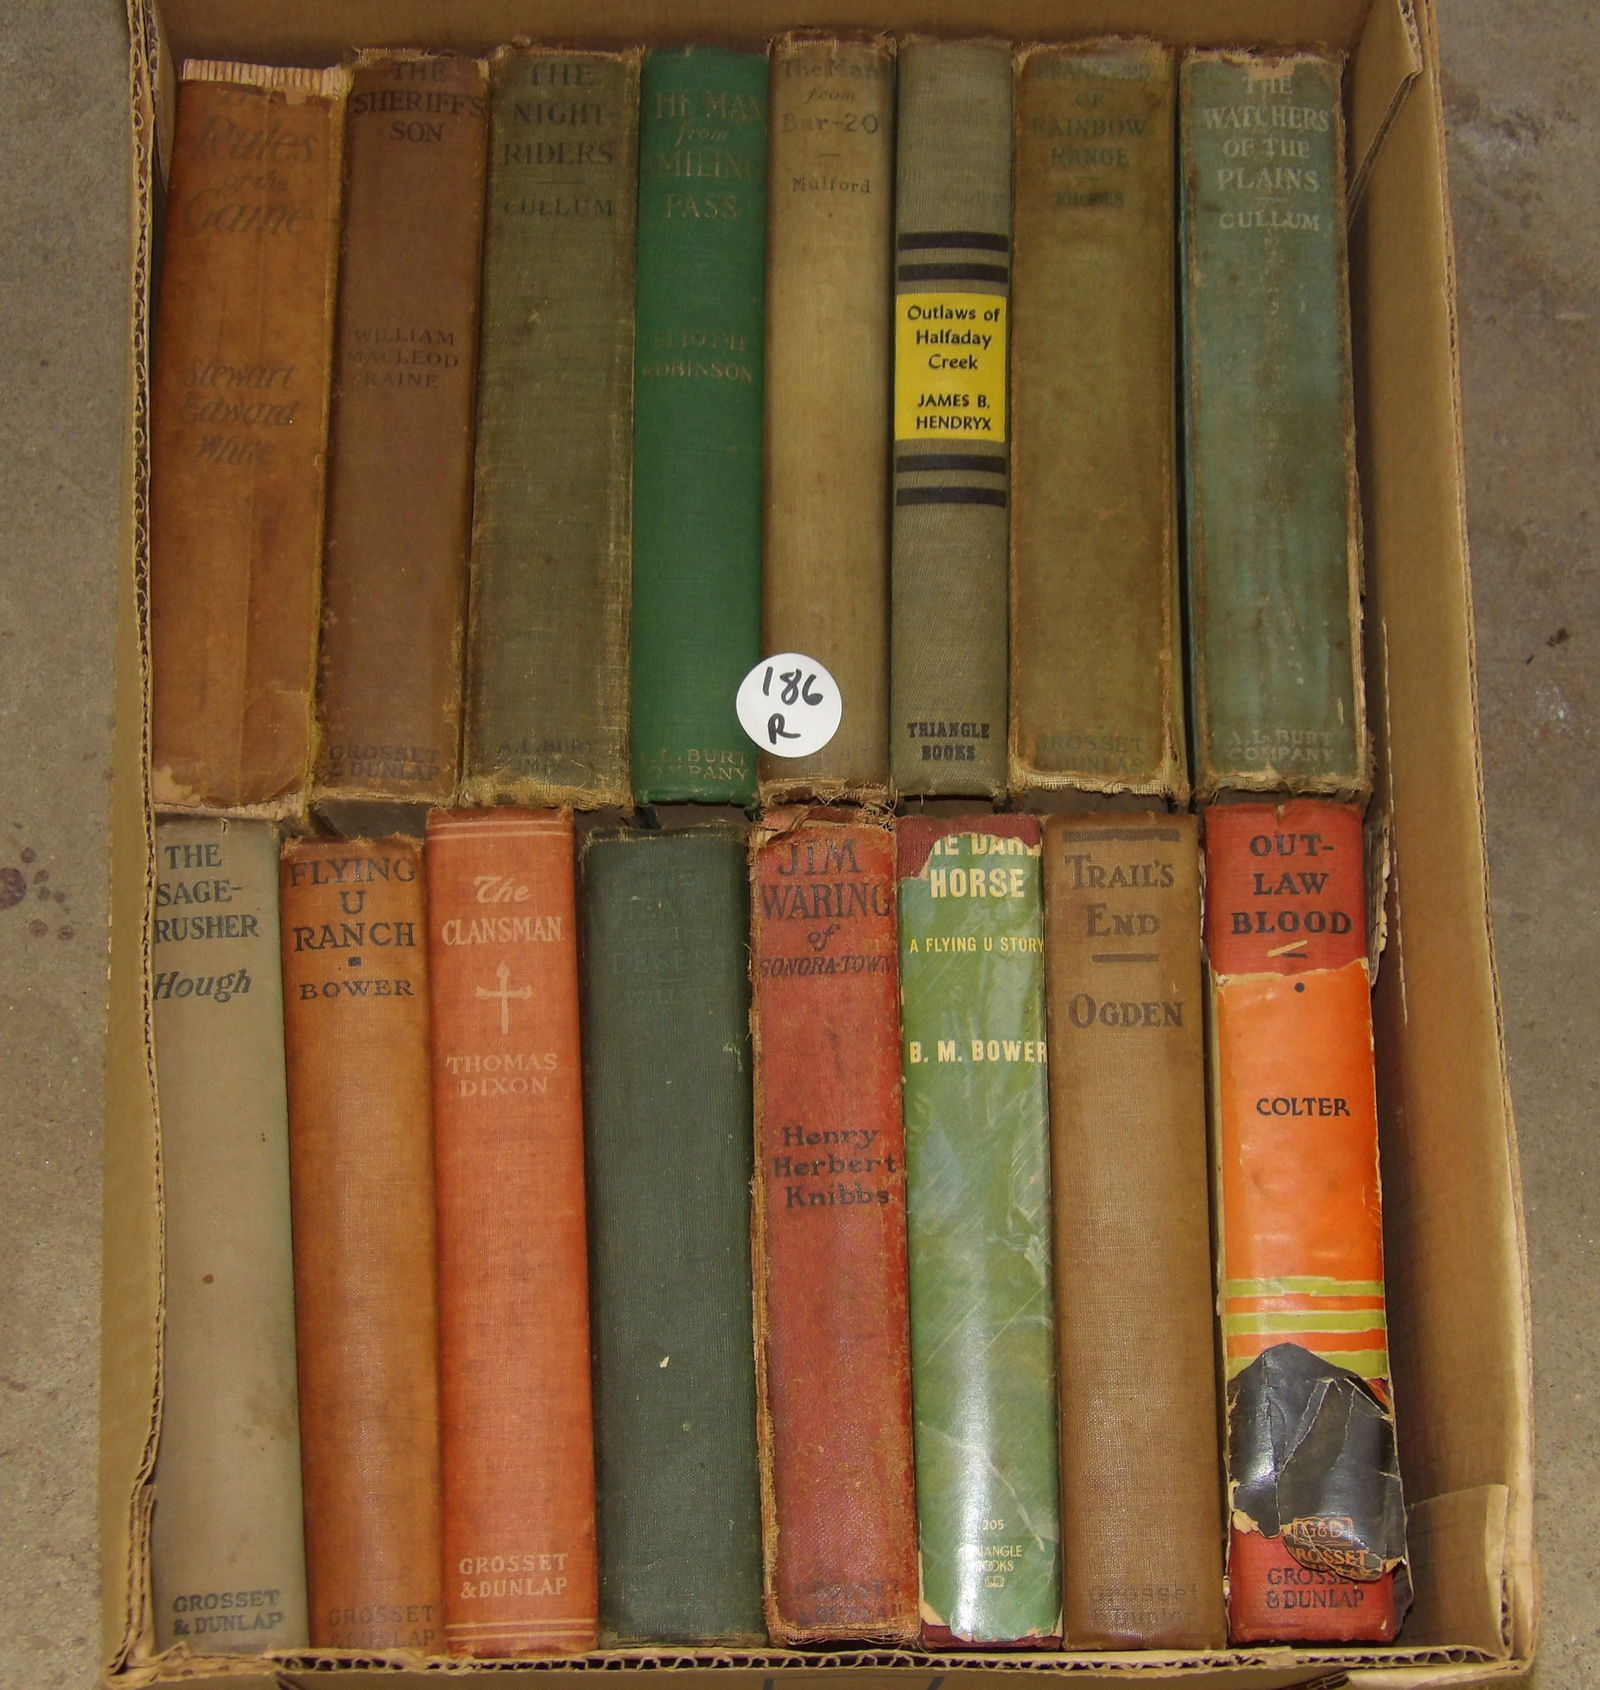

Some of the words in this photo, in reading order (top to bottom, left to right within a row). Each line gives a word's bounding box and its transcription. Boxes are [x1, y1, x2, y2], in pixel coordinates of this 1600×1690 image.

[391, 61, 448, 83] THE
[532, 62, 594, 88] THE
[803, 85, 855, 104] from
[1241, 75, 1294, 96] THE
[1075, 92, 1105, 108] OF
[780, 112, 879, 134] Bar-20
[1031, 118, 1147, 137] RAINBOW
[1202, 104, 1330, 133] WATCHERS
[196, 115, 319, 163] Rules
[388, 120, 445, 143] SON
[674, 119, 729, 147] from
[503, 141, 615, 166] RIDERS
[1050, 147, 1131, 167] RANGE
[1222, 137, 1255, 158] OF
[1263, 135, 1312, 159] THE
[792, 176, 871, 194] Mulford
[1216, 167, 1321, 193] PLAINS
[184, 189, 316, 236] Game
[504, 198, 614, 218] CULLUM
[665, 192, 740, 220] PASS
[1218, 211, 1321, 233] CULLUM
[907, 304, 977, 321] Outlaws
[983, 308, 1001, 322] of
[351, 327, 455, 347] WILLIAM
[915, 329, 993, 351] Halfaday
[928, 353, 979, 370] Creek
[184, 359, 297, 391] Stewart
[364, 371, 440, 389] RAINE
[179, 391, 299, 426] Edward
[917, 393, 970, 408] JAMES
[977, 394, 991, 408] B.
[915, 415, 992, 431] HENDRYX
[762, 665, 824, 707] 186
[767, 712, 802, 745] R
[906, 722, 991, 740] TRIANGLE
[328, 744, 440, 764] GROSSET
[920, 744, 977, 762] BOOKS
[1036, 734, 1143, 752] GROSSET
[1227, 747, 1336, 762] COMPANY
[164, 842, 223, 871] THE
[778, 838, 862, 876] JIM
[1249, 833, 1335, 858] OUT-
[288, 857, 417, 888] FLYING
[929, 868, 1025, 899] HORSE
[1252, 872, 1330, 896] LAW
[156, 878, 244, 908] SAGE-
[339, 890, 366, 915] U
[473, 876, 532, 905] The
[759, 882, 891, 922] WARING
[154, 913, 261, 945] RUSHER
[1231, 911, 1352, 936] BLOOD
[292, 922, 416, 952] RANCH
[806, 923, 841, 951] of
[909, 938, 918, 953] A
[926, 936, 976, 952] FLYING
[983, 937, 993, 951] U
[1000, 936, 1044, 953] STORY
[154, 968, 252, 1003] Hough
[299, 979, 414, 1001] BOWER
[446, 1052, 559, 1076] THOMAS
[909, 1041, 928, 1064] B.
[938, 1040, 963, 1063] M.
[971, 1040, 1048, 1064] BOWER
[459, 1076, 547, 1098] DIXON
[1255, 1097, 1351, 1117] COLTER
[781, 1125, 880, 1151] Henry
[772, 1152, 897, 1178] Herbert
[784, 1181, 890, 1209] Knibbs
[982, 1519, 1005, 1531] 205
[458, 1552, 569, 1575] GROSSET
[1290, 1548, 1370, 1568] ROSSET
[172, 1588, 280, 1613] GROSSET
[328, 1605, 435, 1626] GROSSET
